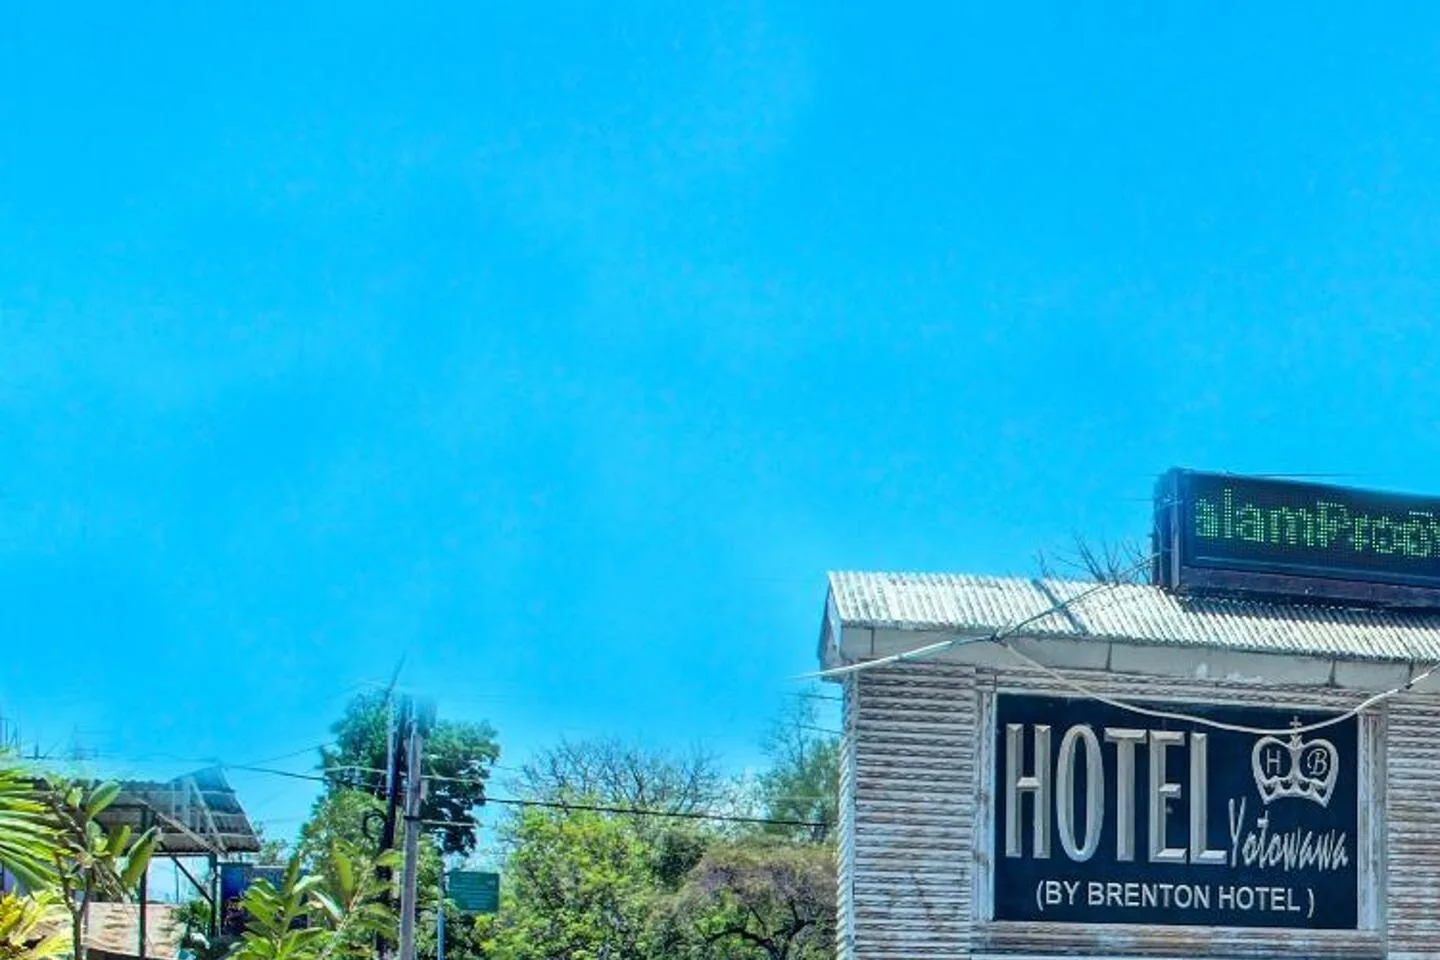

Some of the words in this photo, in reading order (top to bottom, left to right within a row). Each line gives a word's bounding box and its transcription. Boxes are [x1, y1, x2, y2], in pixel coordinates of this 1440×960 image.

[1265, 748, 1281, 775] H
[1306, 748, 1328, 776] B
[1005, 723, 1228, 865] HOTEL
[1036, 880, 1080, 911] (BY
[1087, 882, 1210, 909] BRENTON
